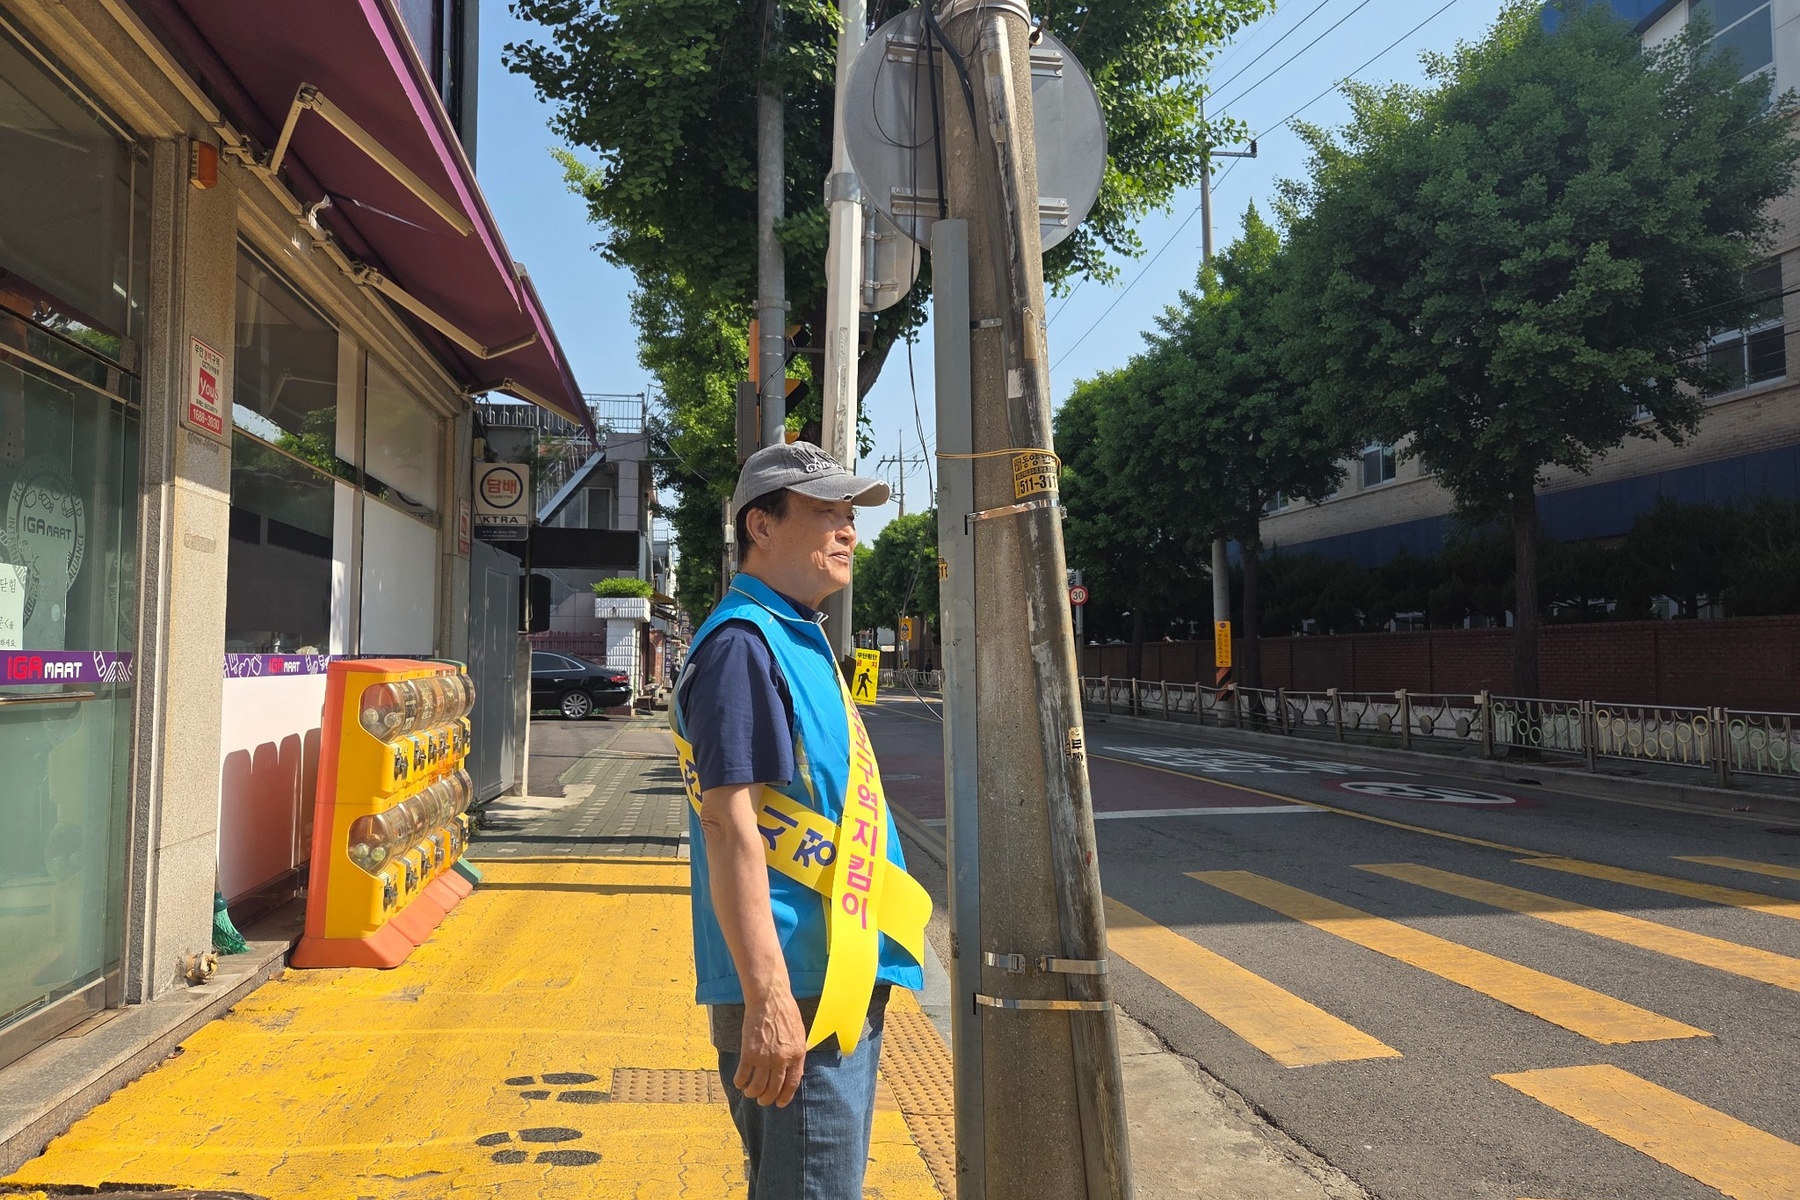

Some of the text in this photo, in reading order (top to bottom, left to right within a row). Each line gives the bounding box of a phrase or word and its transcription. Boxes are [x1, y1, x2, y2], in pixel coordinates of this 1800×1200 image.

[487, 479, 517, 494] 담배
[23, 515, 46, 536] IGA
[483, 516, 519, 524] KTRA
[1072, 590, 1084, 600] 30
[857, 652, 877, 661] 무단횡단
[7, 655, 43, 680] IGA
[268, 657, 284, 673] IGA
[1346, 783, 1501, 801] 30
